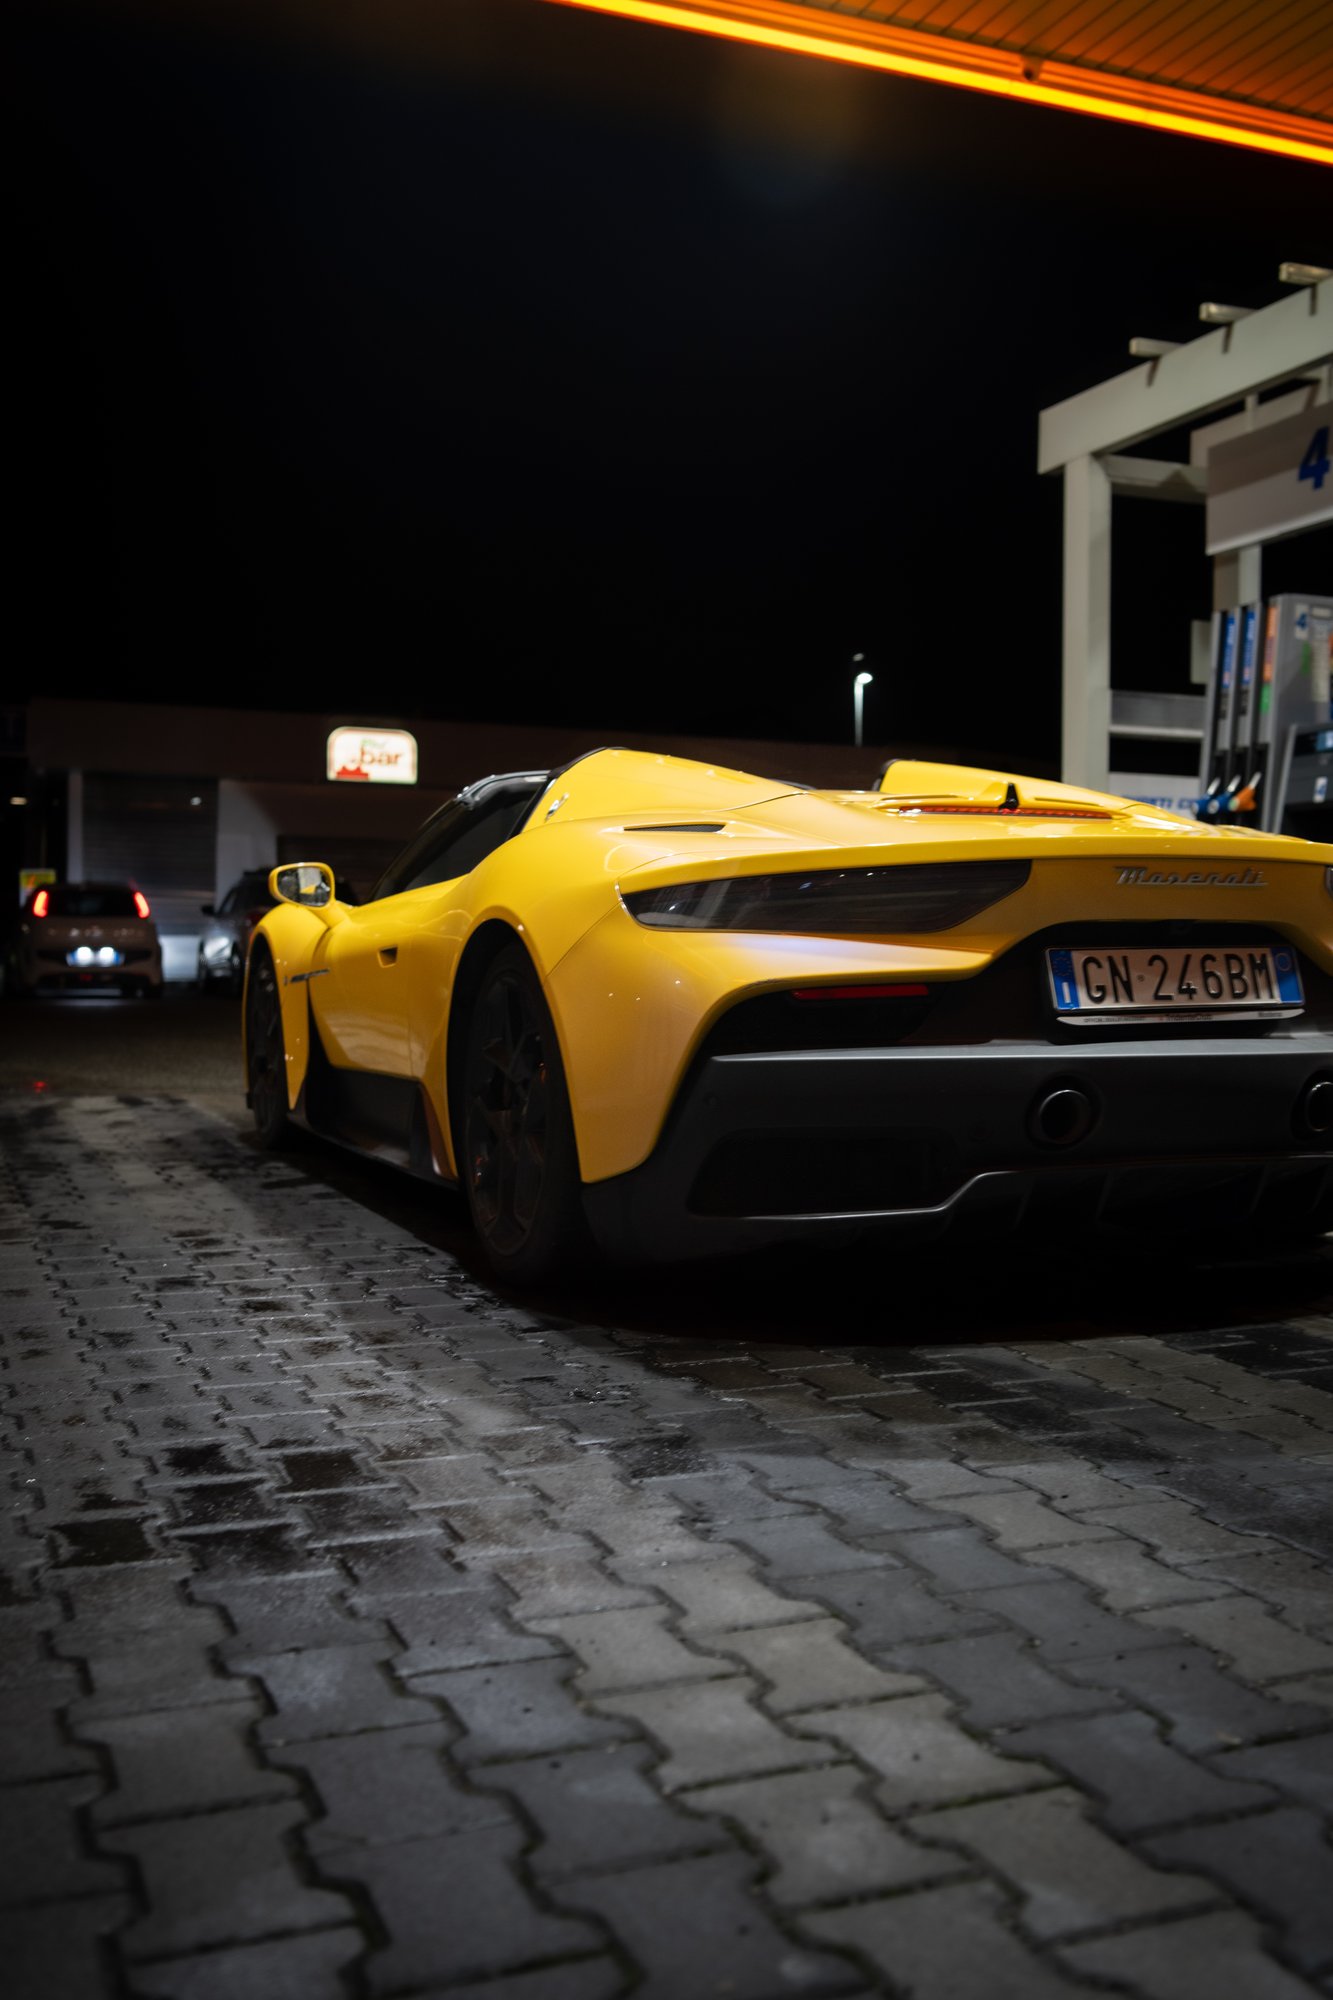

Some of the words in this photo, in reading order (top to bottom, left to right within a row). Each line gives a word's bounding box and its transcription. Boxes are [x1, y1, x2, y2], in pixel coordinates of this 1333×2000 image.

[1298, 427, 1330, 490] 4
[358, 743, 403, 764] bar
[1114, 866, 1268, 887] Maserati
[1083, 955, 1134, 1003] GN
[1148, 953, 1274, 1001] 246BM
